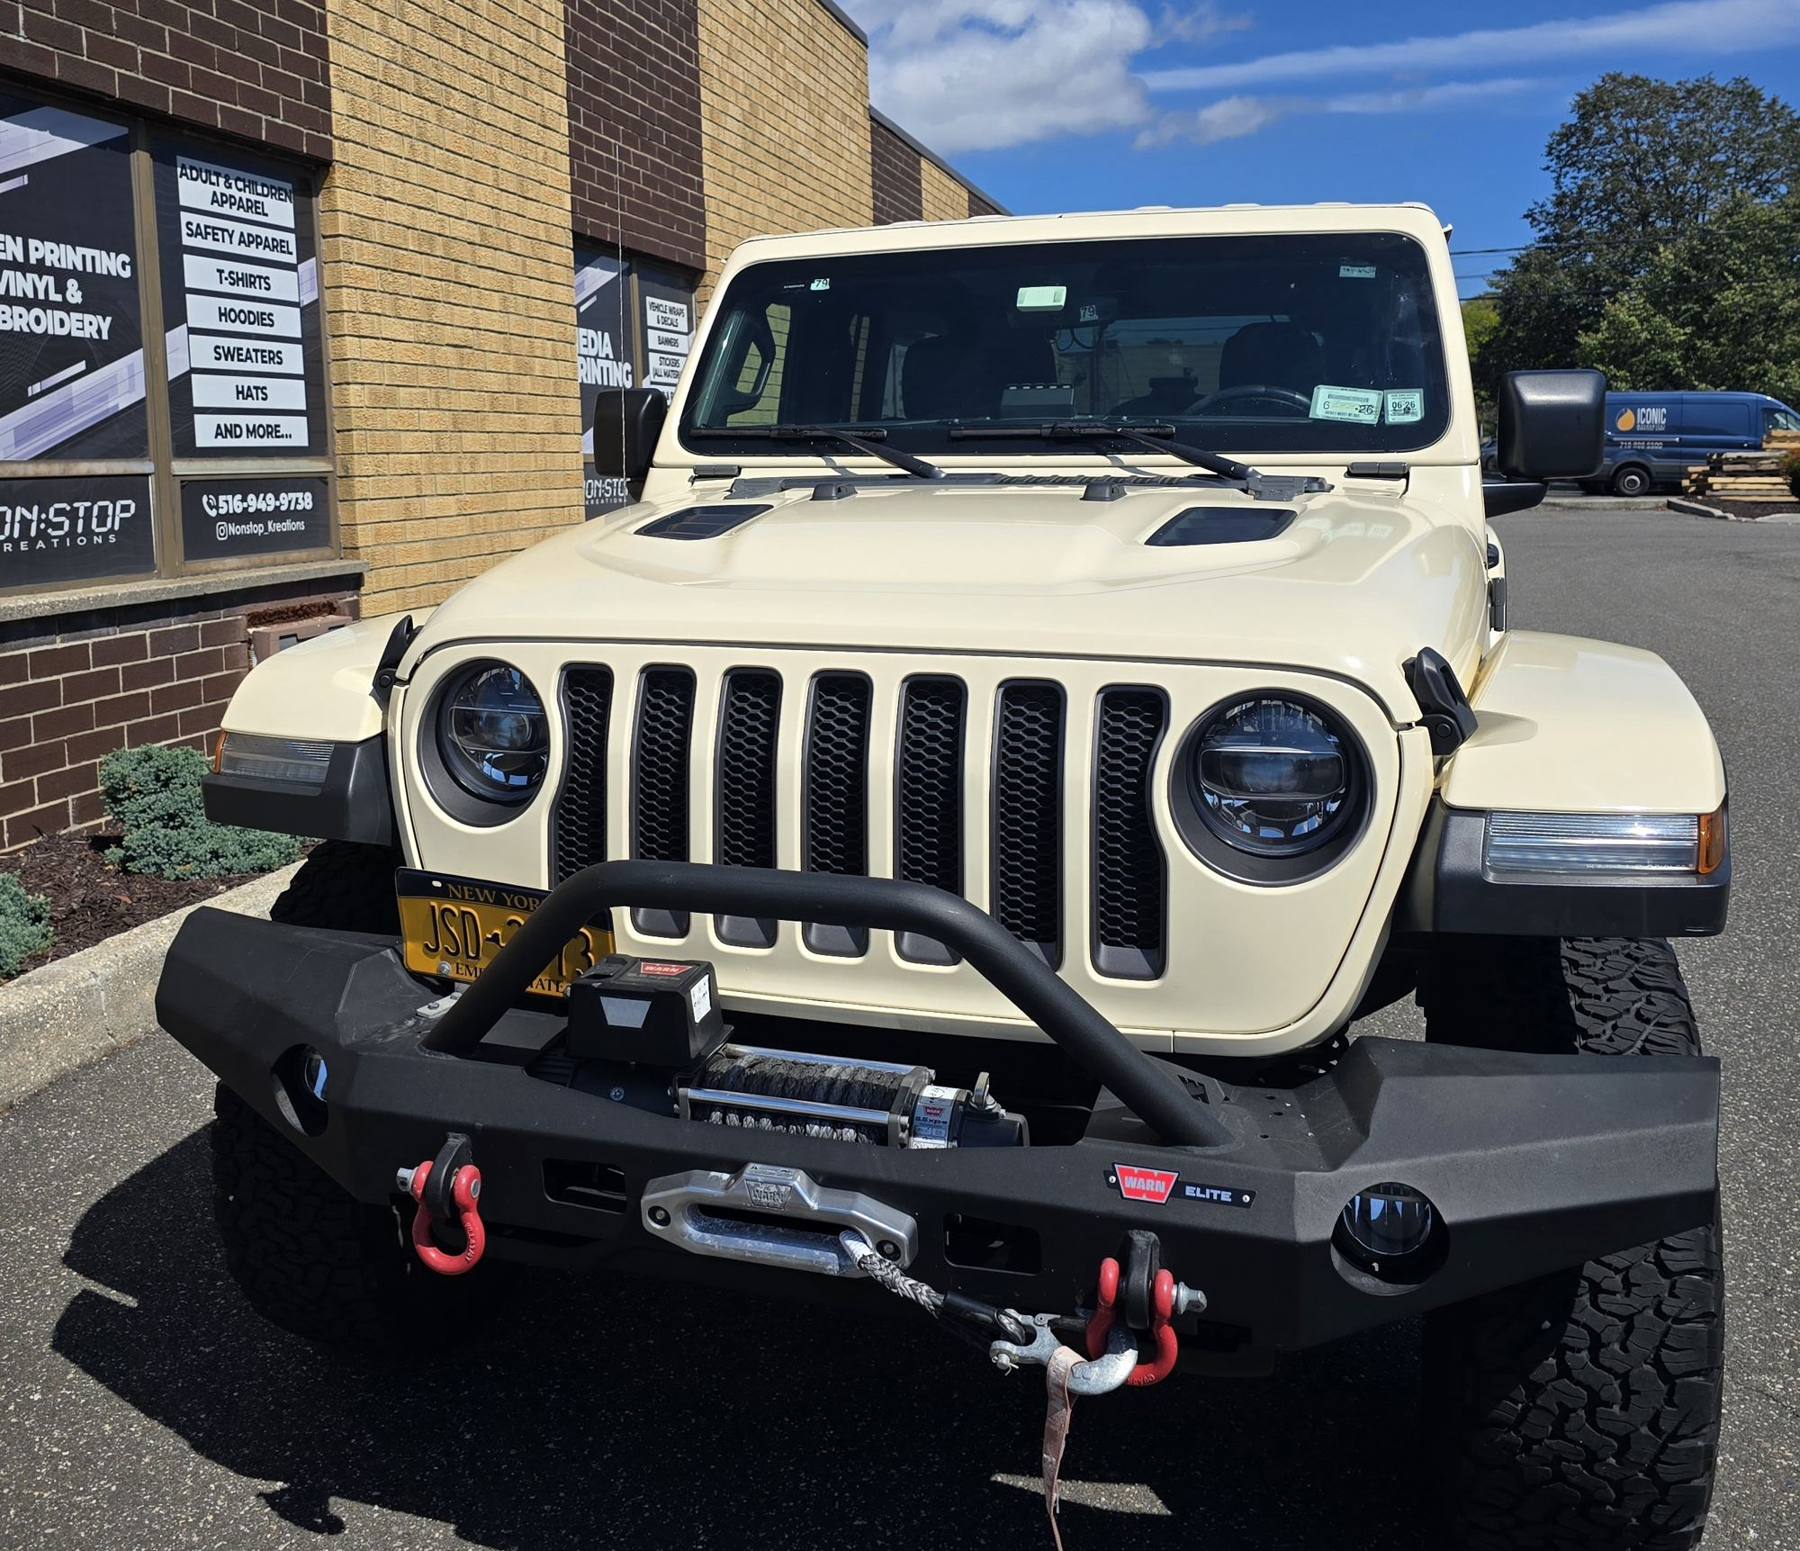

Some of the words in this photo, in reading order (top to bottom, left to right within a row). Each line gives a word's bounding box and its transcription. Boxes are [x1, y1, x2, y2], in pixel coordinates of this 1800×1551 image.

[179, 163, 221, 185] ADULT
[223, 174, 233, 189] &
[234, 176, 293, 204] CHILDREN
[210, 191, 269, 217] APPAREL
[185, 221, 235, 245] SAFETY
[237, 231, 293, 255] APPAREL
[28, 238, 132, 279] PRINTING
[66, 278, 83, 304] &
[216, 268, 271, 291] T-SHIRTS
[218, 306, 275, 328] HOODIES
[213, 345, 283, 365] SWEATERS
[235, 385, 268, 401] HATS
[1636, 407, 1667, 425] ICONIC
[214, 424, 243, 439] AND
[246, 424, 292, 439] MORE...
[218, 491, 313, 515] 516-949-9738
[228, 520, 305, 536] Nonstop_Kreations
[447, 883, 497, 904] NEW
[501, 893, 545, 912] YOR
[1124, 1175, 1167, 1194] WARN
[1185, 1185, 1232, 1202] ELITE
